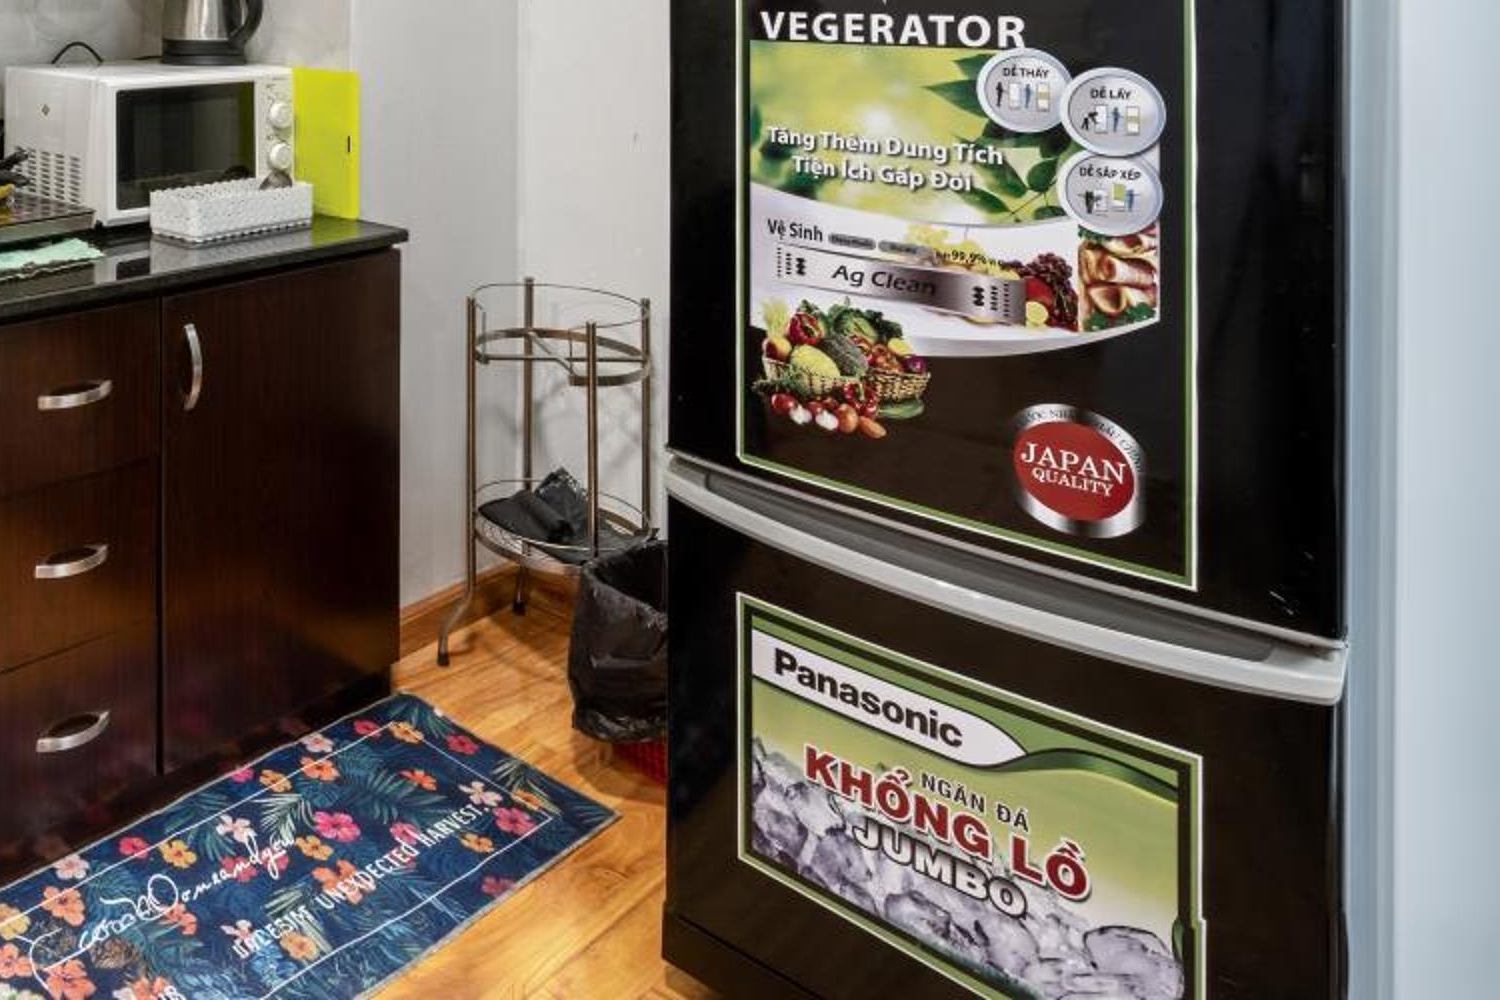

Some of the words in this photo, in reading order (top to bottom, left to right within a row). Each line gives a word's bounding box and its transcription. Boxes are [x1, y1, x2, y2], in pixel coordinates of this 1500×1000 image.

[760, 11, 1026, 49] VEGERATOR
[791, 155, 836, 180] Tiện
[886, 138, 948, 165] Dung
[952, 143, 1003, 165] Tích
[789, 223, 823, 242] Sinh
[832, 265, 865, 287] Ag
[871, 271, 937, 296] Clean
[1020, 443, 1127, 485] JAPAN
[1031, 467, 1114, 497] QUALITY
[775, 648, 963, 747] Panasonic
[805, 745, 992, 861] KHỔNG
[852, 818, 1029, 920] JUMBO
